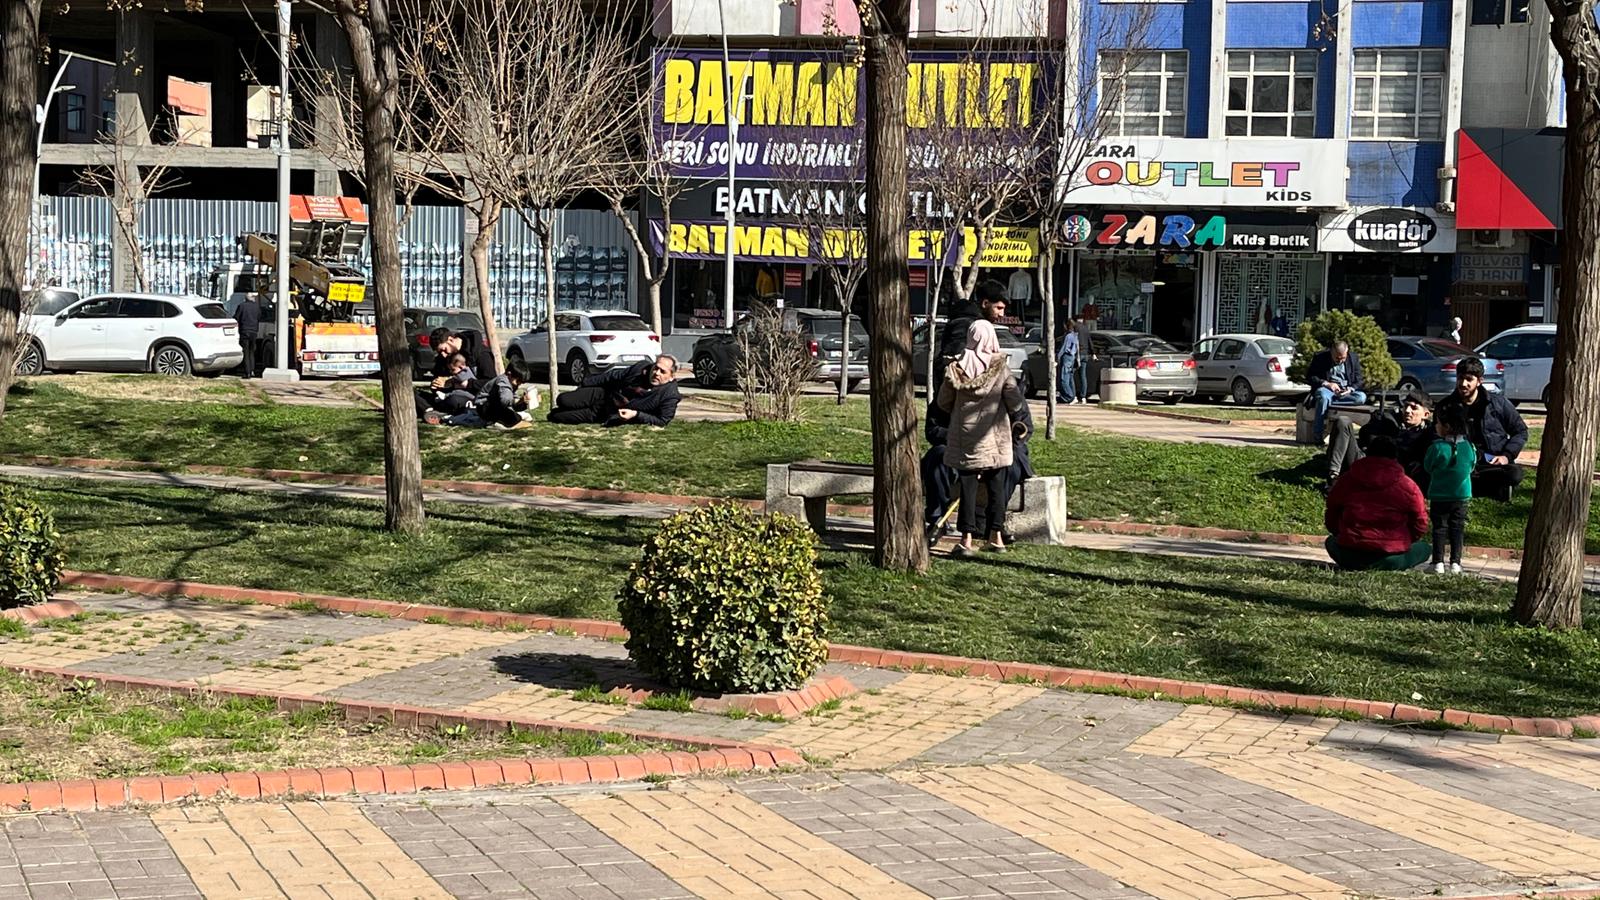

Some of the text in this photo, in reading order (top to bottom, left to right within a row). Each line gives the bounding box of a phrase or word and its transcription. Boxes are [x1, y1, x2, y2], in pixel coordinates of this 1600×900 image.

[664, 59, 1039, 128] BATMAN UTLET
[662, 136, 705, 163] SERİ
[707, 141, 759, 164] SONU
[1085, 160, 1301, 187] OUTLET
[715, 186, 844, 215] BATMAN
[668, 224, 945, 260] BATMAN OUET
[1096, 213, 1310, 248] ZARA Kids Butik
[1355, 219, 1432, 241] kuaför
[967, 253, 1004, 263] GMRÜK
[1463, 255, 1521, 266] BULVAR
